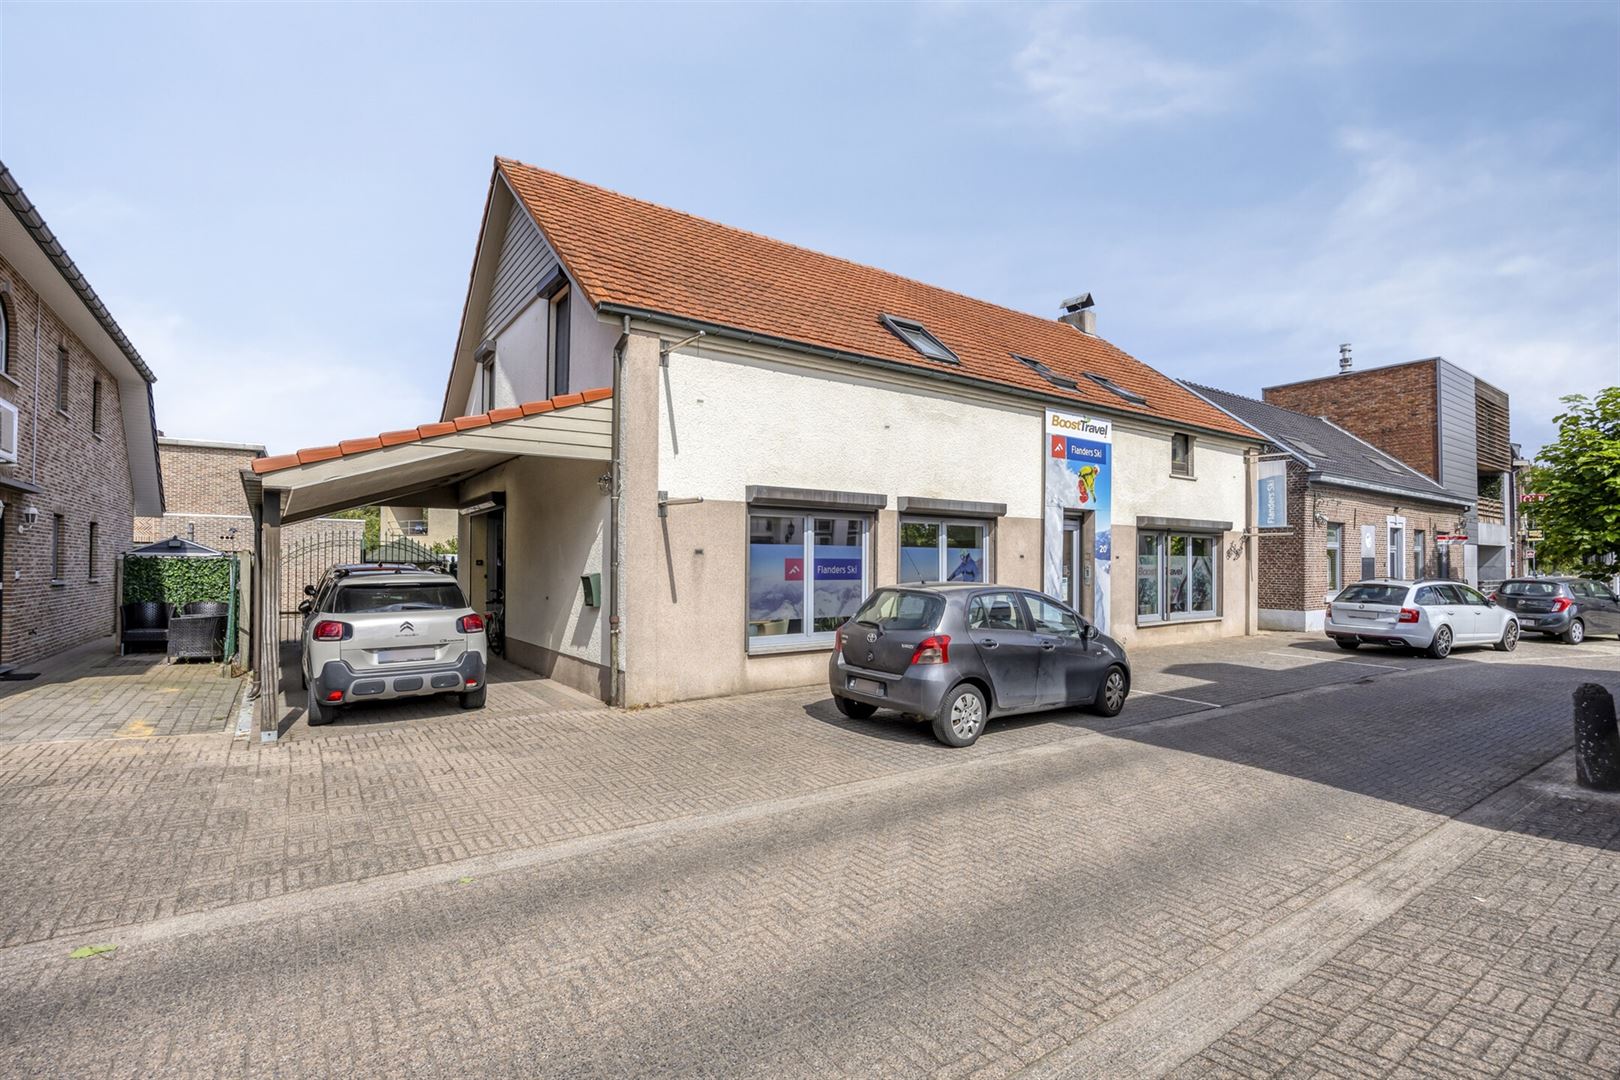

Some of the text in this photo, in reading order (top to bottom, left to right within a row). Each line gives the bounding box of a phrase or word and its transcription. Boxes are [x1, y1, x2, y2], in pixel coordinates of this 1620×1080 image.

[1051, 414, 1108, 437] BoostTravel
[1071, 445, 1102, 458] Flanders Ski
[1266, 479, 1275, 524] Flanders Ski
[817, 564, 858, 575] Flanders Ski
